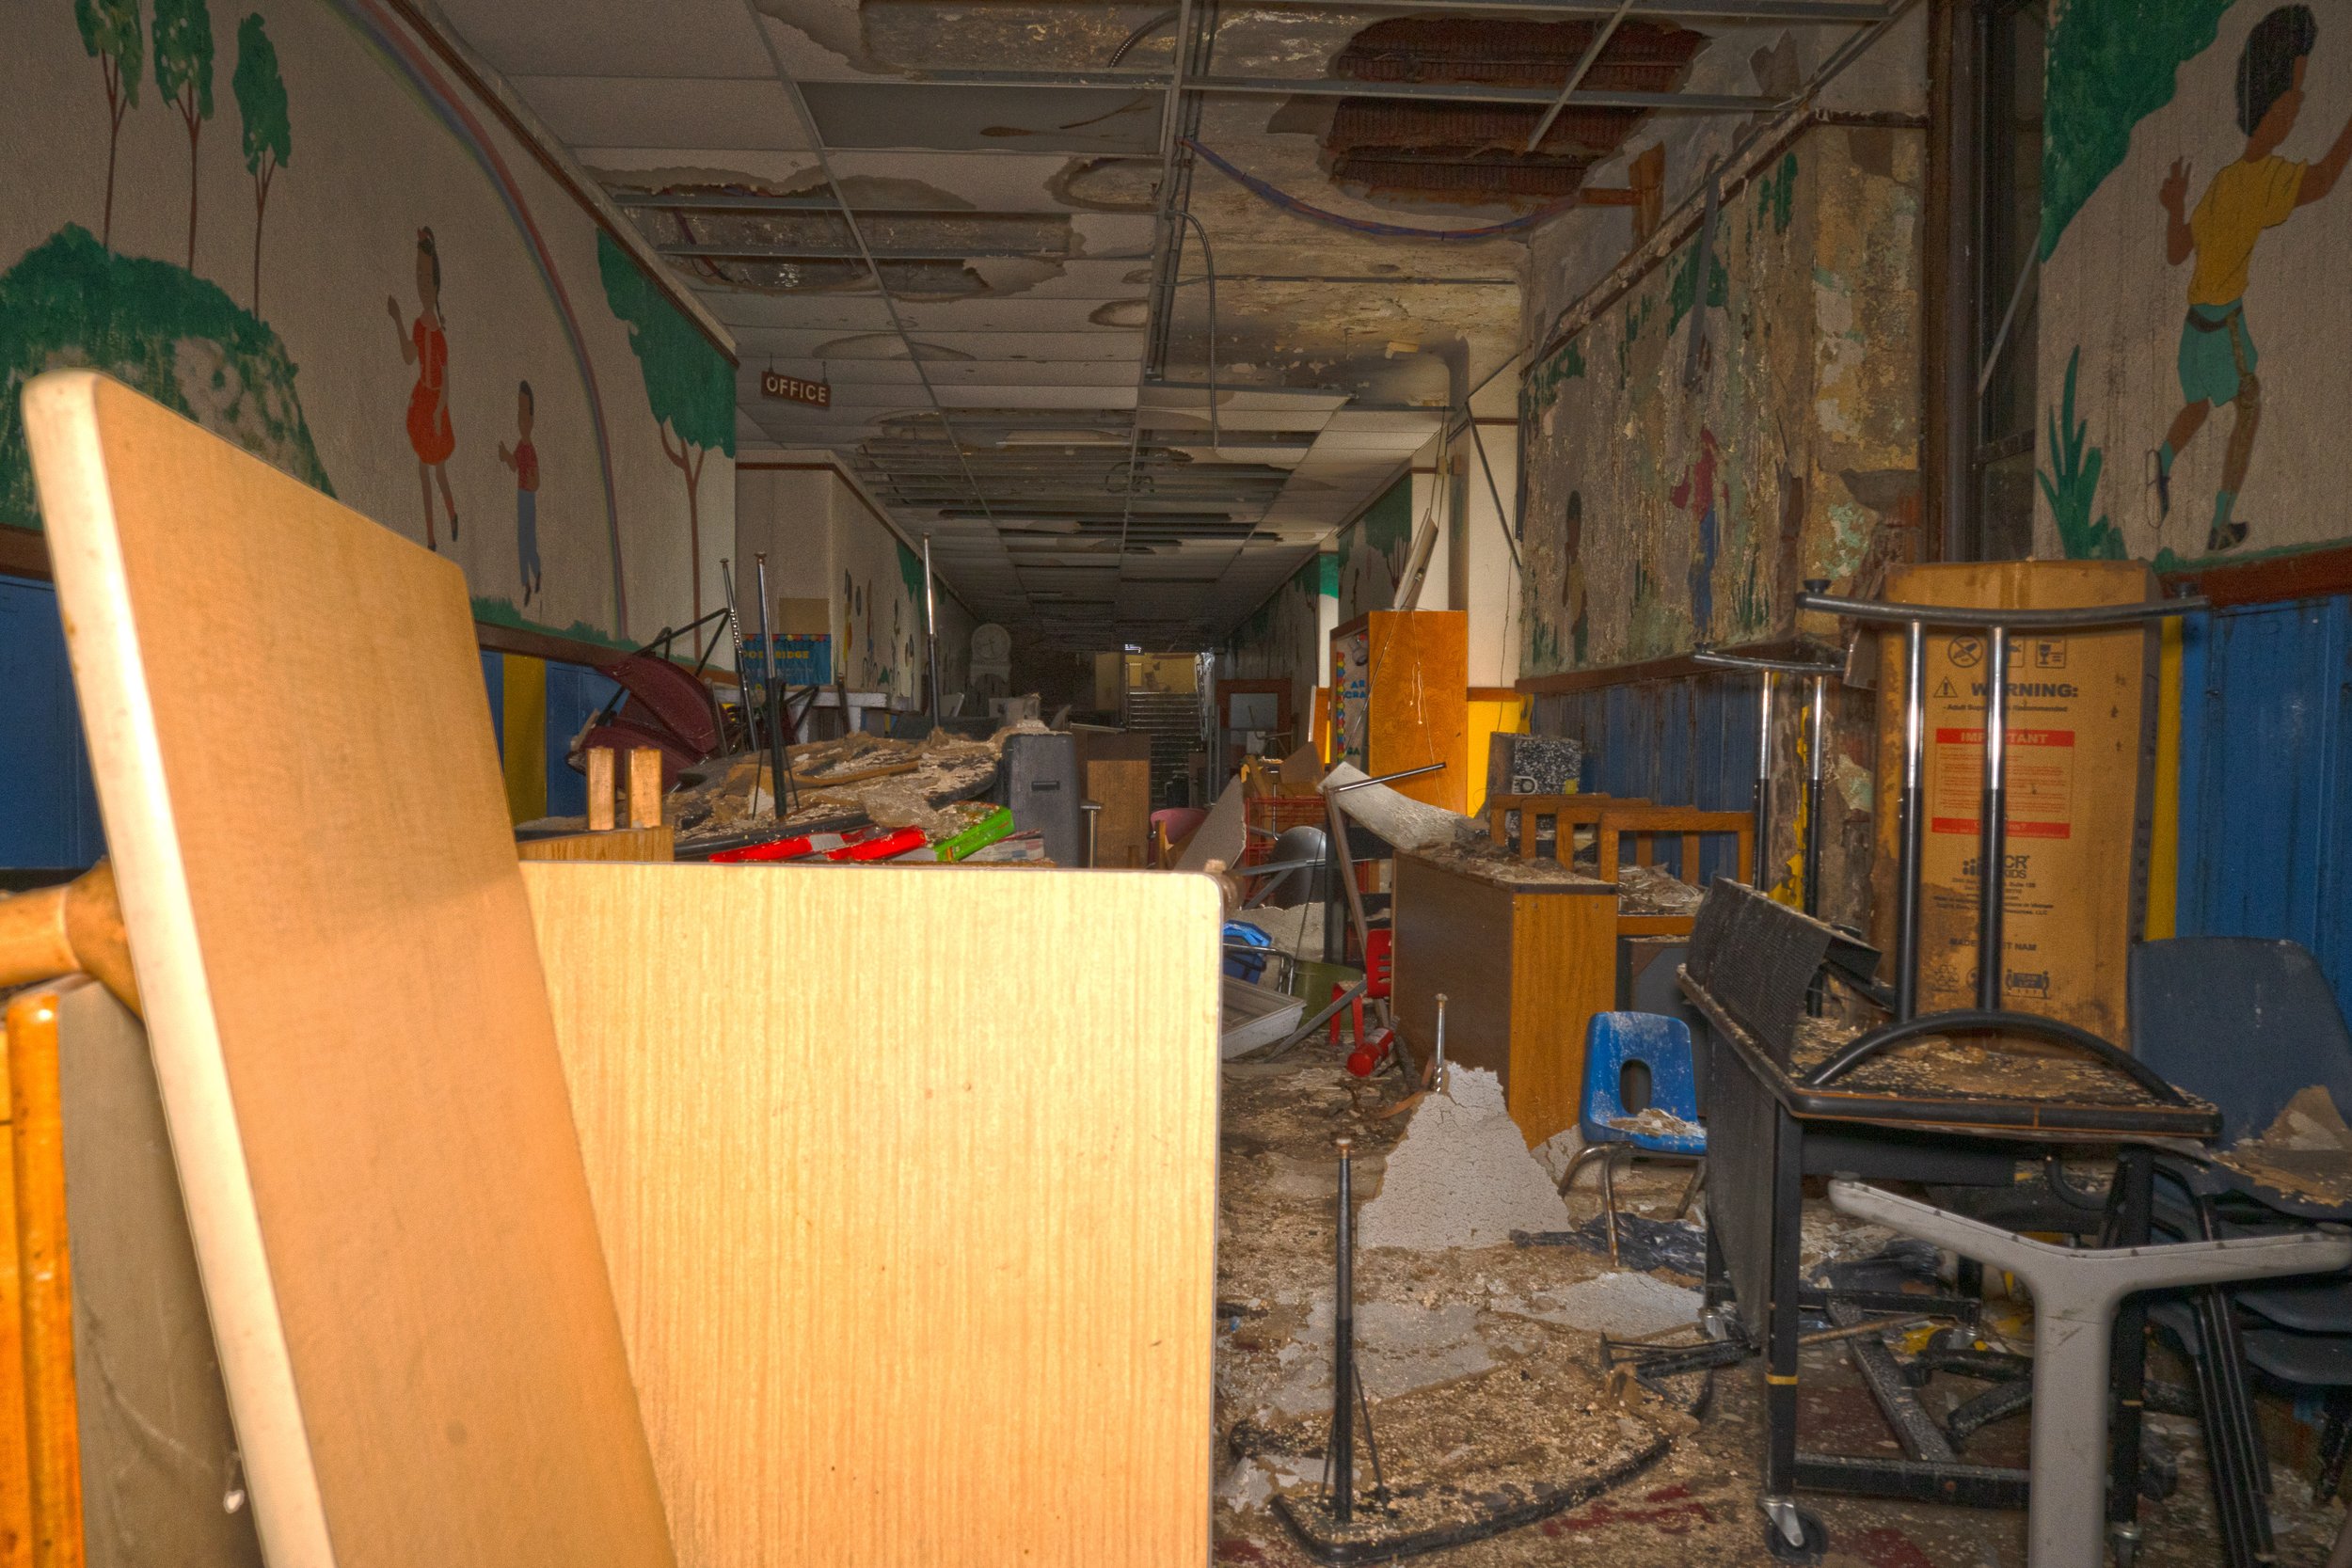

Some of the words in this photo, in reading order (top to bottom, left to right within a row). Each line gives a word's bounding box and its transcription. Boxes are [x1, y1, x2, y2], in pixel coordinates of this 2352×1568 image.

[766, 376, 827, 403] OFFICE
[1972, 682, 2079, 698] WRNING:
[1961, 732, 2048, 744] IMPTANT
